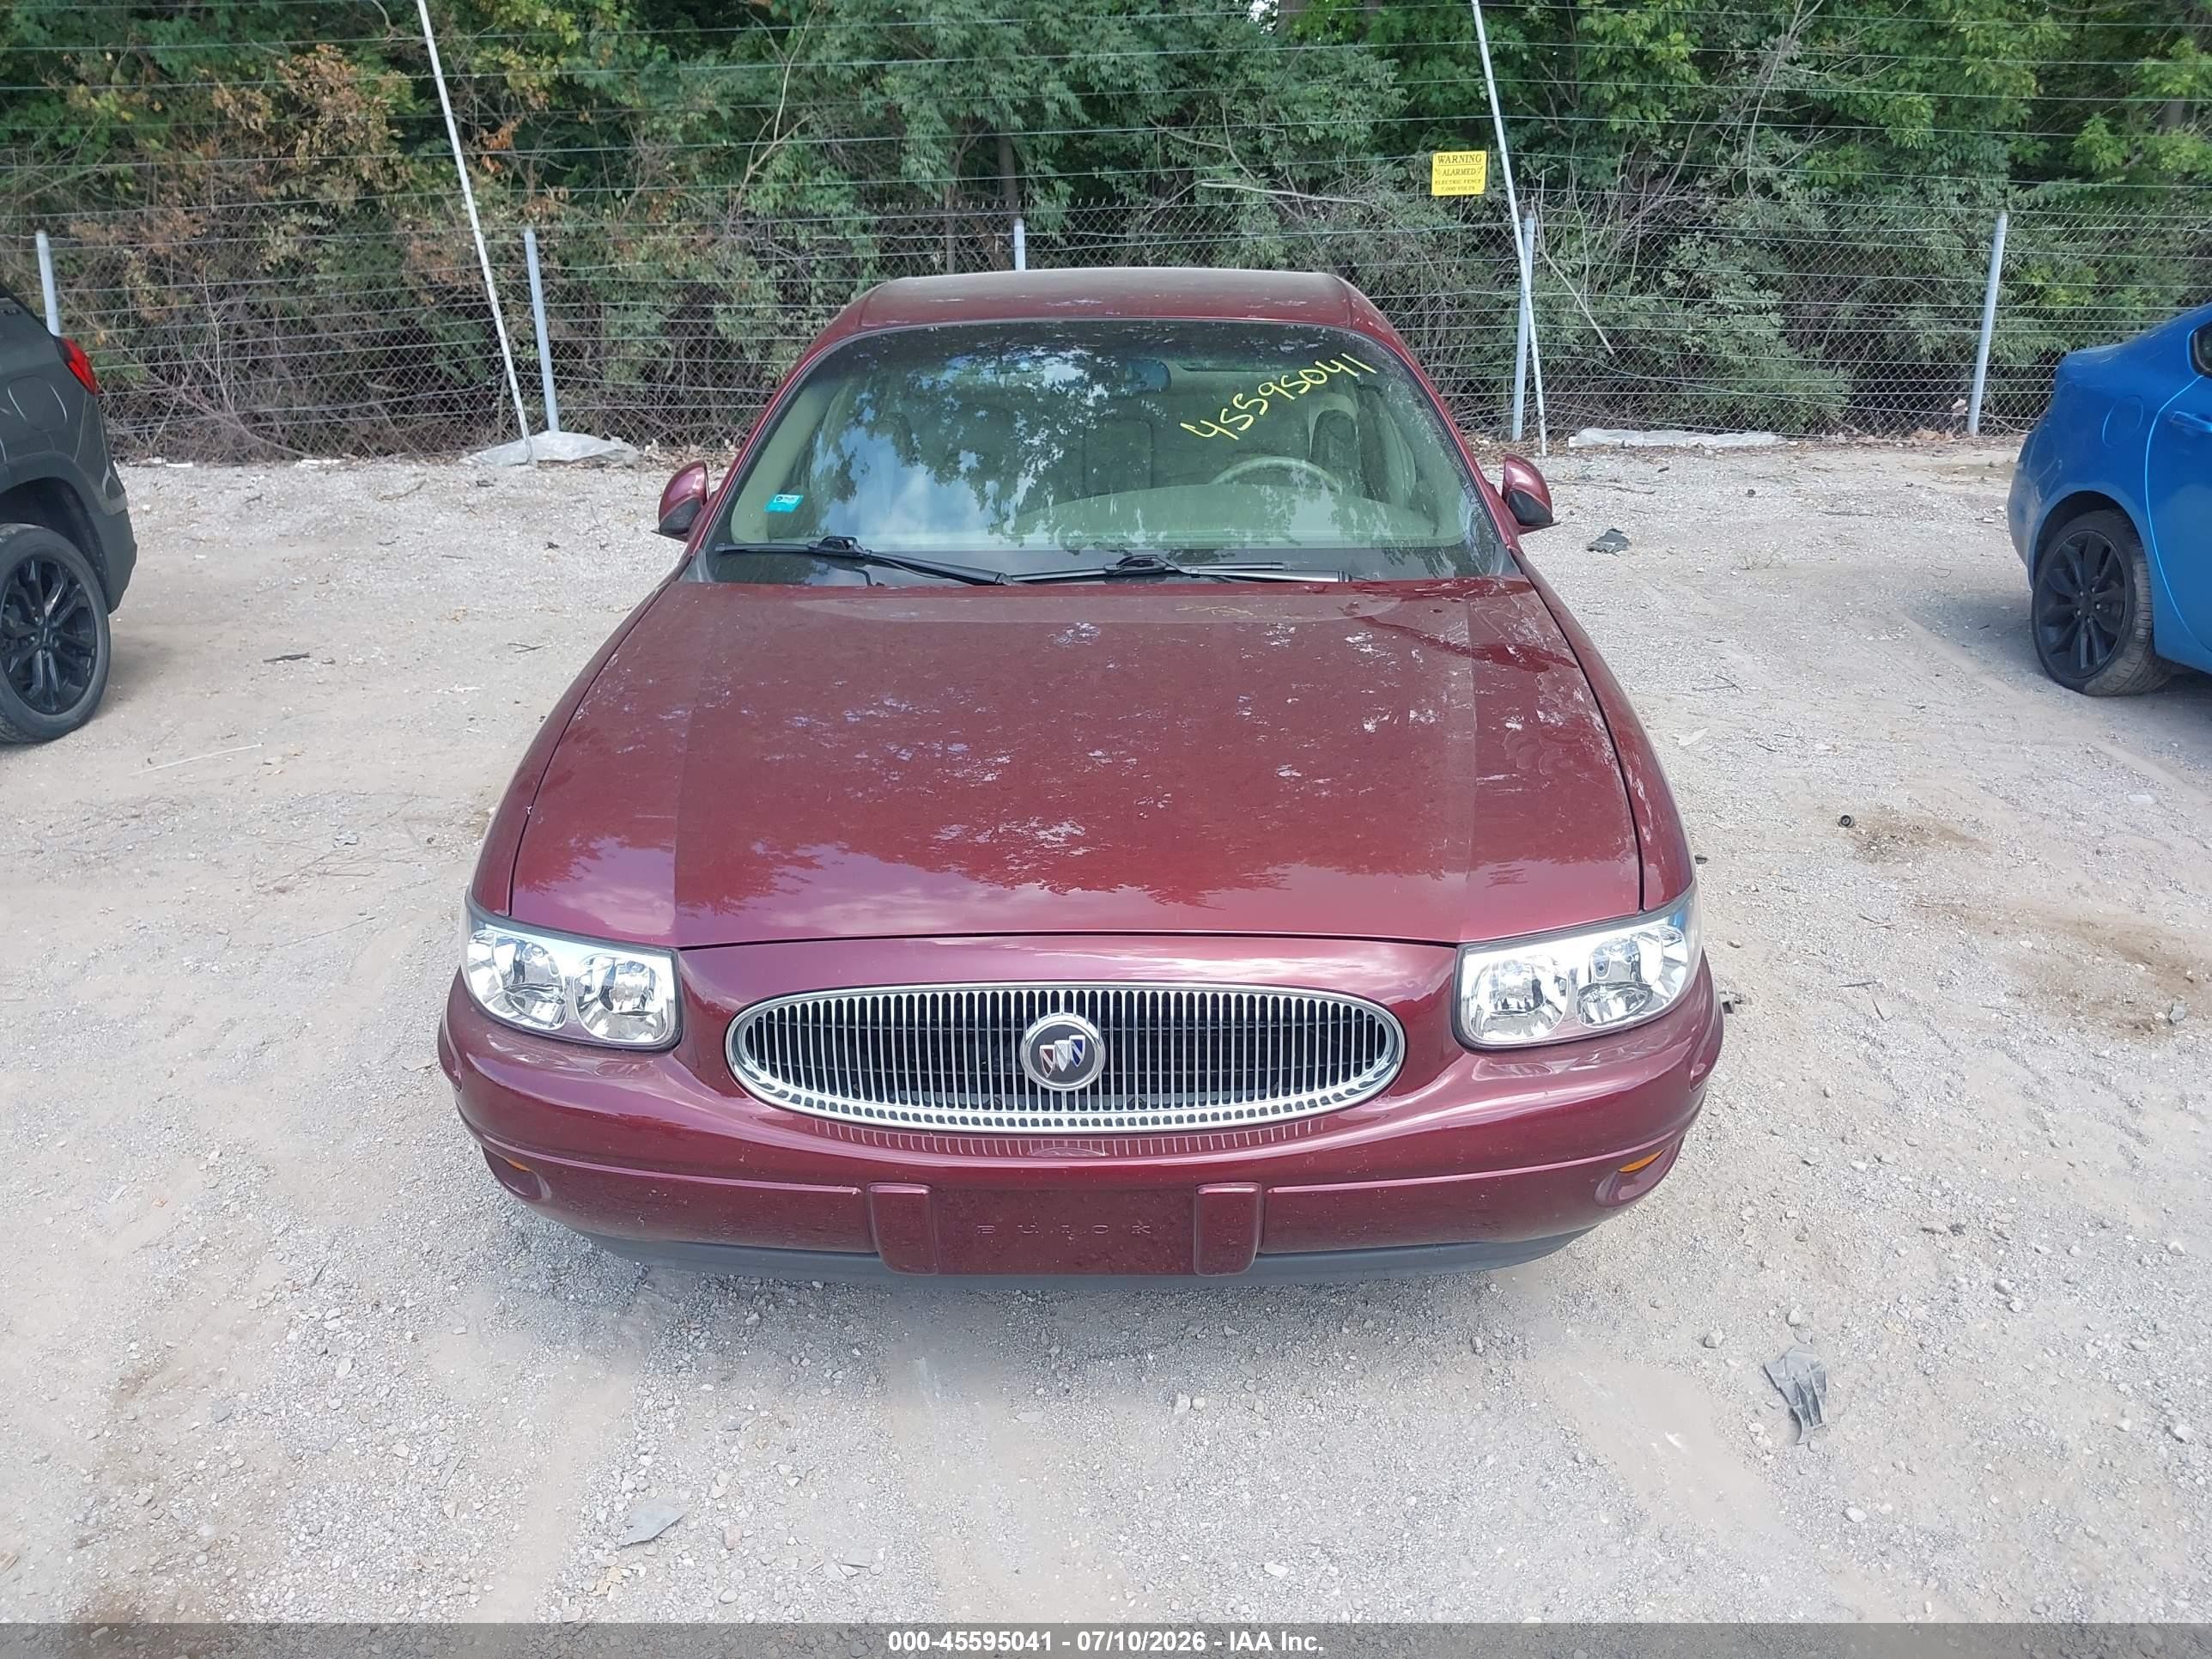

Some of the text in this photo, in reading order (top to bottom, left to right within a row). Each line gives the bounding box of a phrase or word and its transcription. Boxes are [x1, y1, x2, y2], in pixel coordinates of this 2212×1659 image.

[1437, 154, 1482, 164] WARNING
[1442, 167, 1476, 177] ALARMED
[1180, 353, 1377, 440] 45595041
[975, 1224, 1152, 1235] BUICK
